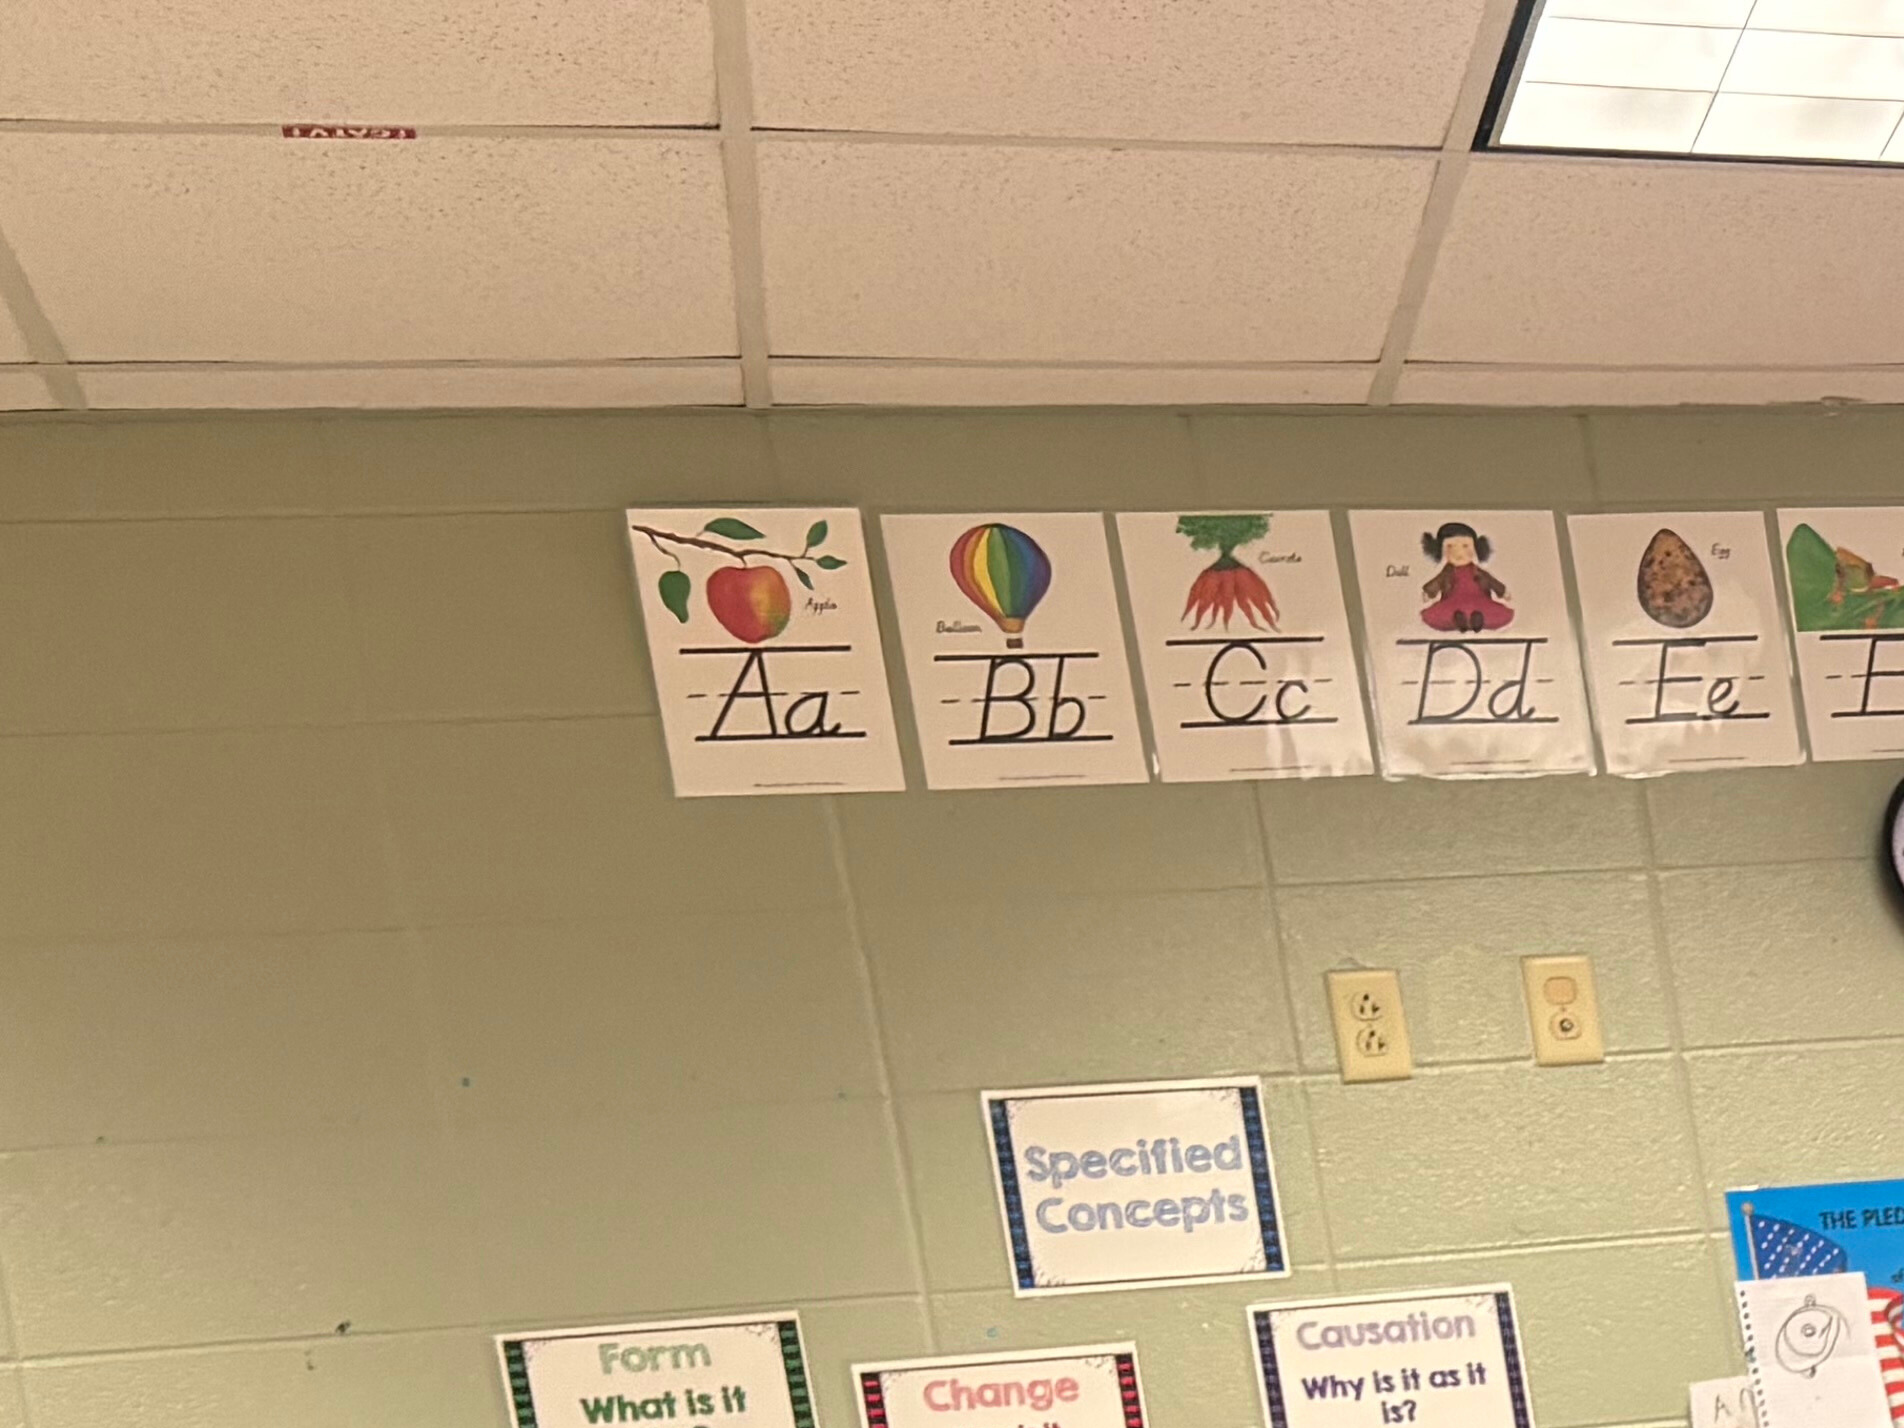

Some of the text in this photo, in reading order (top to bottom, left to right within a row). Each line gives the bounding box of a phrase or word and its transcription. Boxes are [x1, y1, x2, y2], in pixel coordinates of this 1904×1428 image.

[711, 648, 841, 738] Aa
[979, 656, 1086, 741] Bb
[1205, 644, 1314, 722] Cc
[1417, 641, 1535, 722] Dd
[1654, 640, 1740, 718] Ee
[1024, 1135, 1242, 1188] Specified
[1036, 1188, 1249, 1233] Concepts
[1819, 1209, 1856, 1230] THE
[1297, 1311, 1475, 1350] Causation
[599, 1342, 712, 1374] Form
[923, 1374, 1080, 1413] Change
[1302, 1362, 1486, 1401] Why is it as it
[581, 1386, 747, 1425] What is it
[1381, 1400, 1416, 1424] is?
